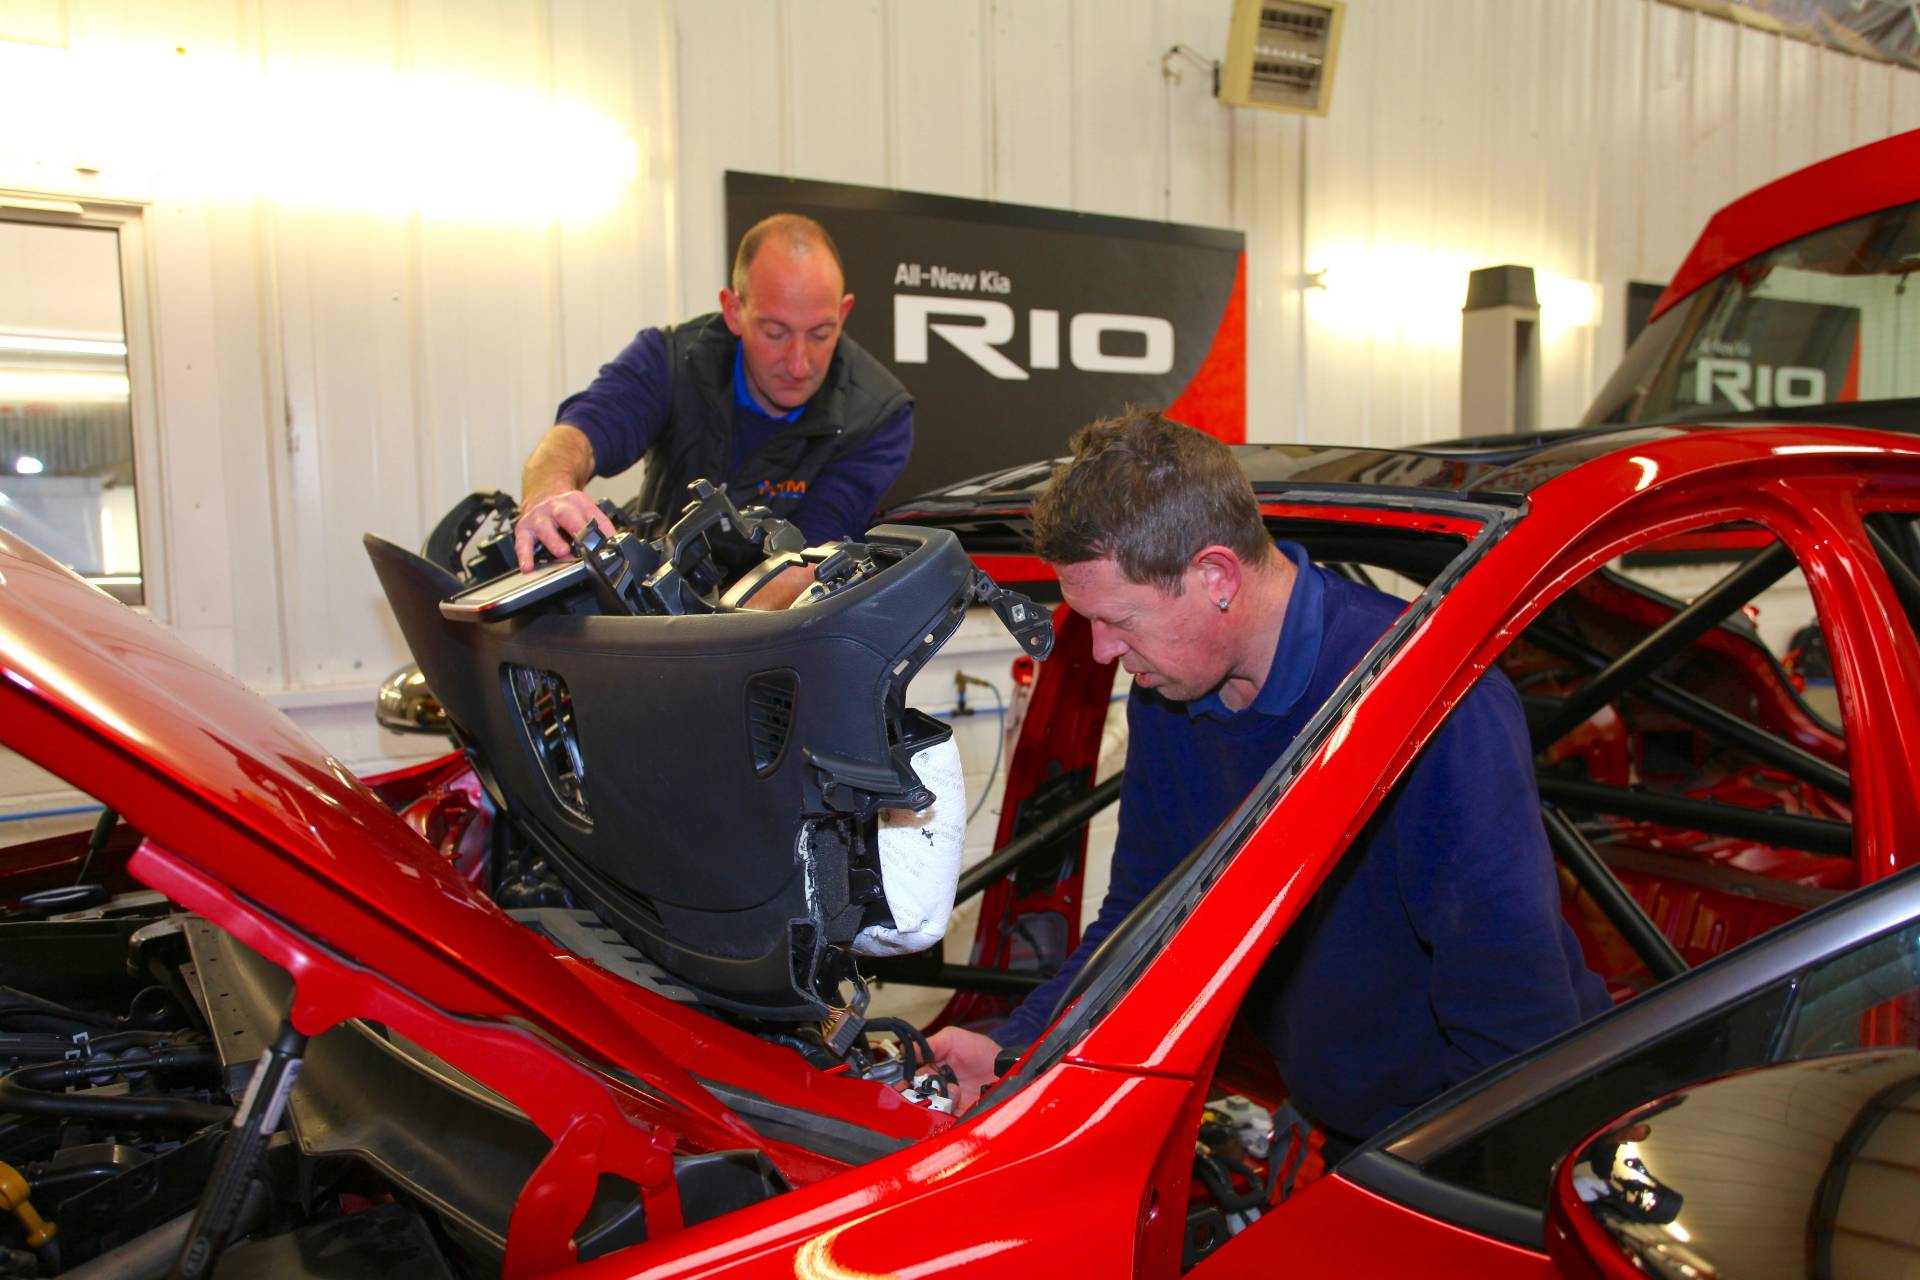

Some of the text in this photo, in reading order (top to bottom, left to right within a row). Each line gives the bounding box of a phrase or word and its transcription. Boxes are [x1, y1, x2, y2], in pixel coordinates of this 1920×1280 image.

[894, 262, 1011, 294] All-New Kia
[894, 294, 1174, 380] RIO
[1696, 357, 1826, 412] RIO
